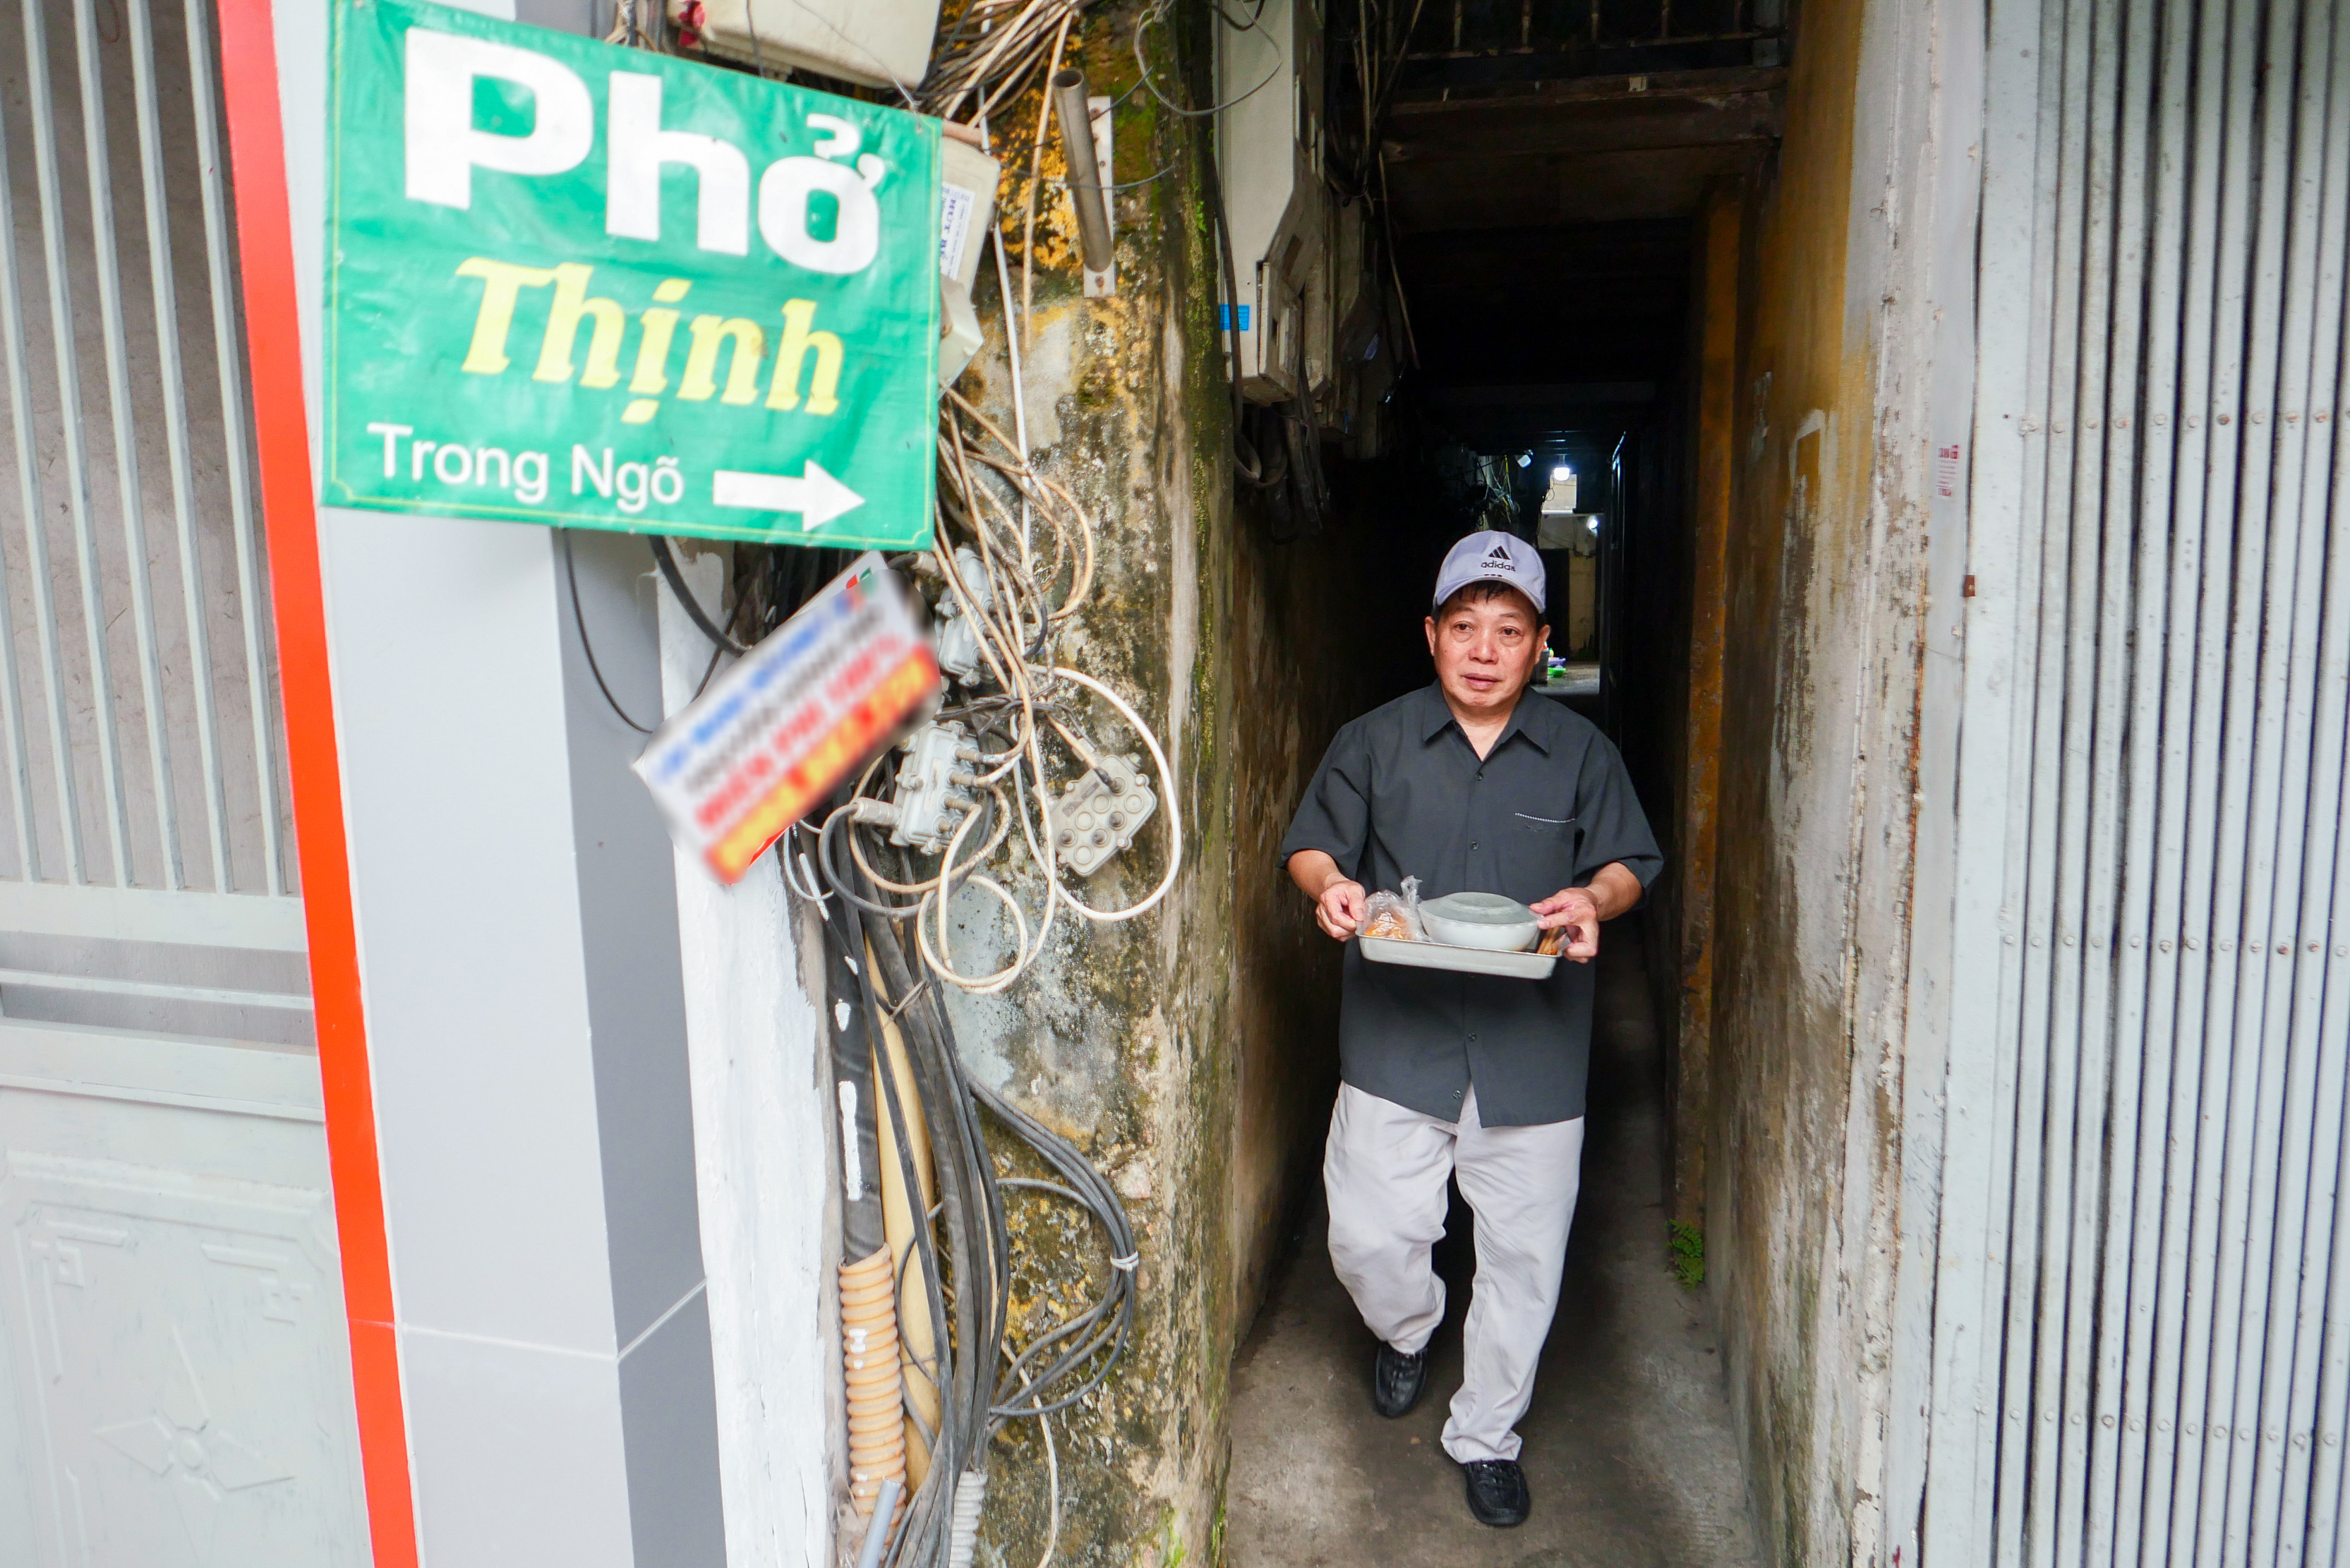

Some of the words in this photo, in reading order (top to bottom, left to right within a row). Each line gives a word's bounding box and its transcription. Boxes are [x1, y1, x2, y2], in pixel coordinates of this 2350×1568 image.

[405, 27, 885, 274] Phở
[455, 256, 845, 423] Thịnh
[366, 422, 549, 504] Trong
[571, 444, 684, 512] Ngõ
[1481, 560, 1516, 572] adidas
